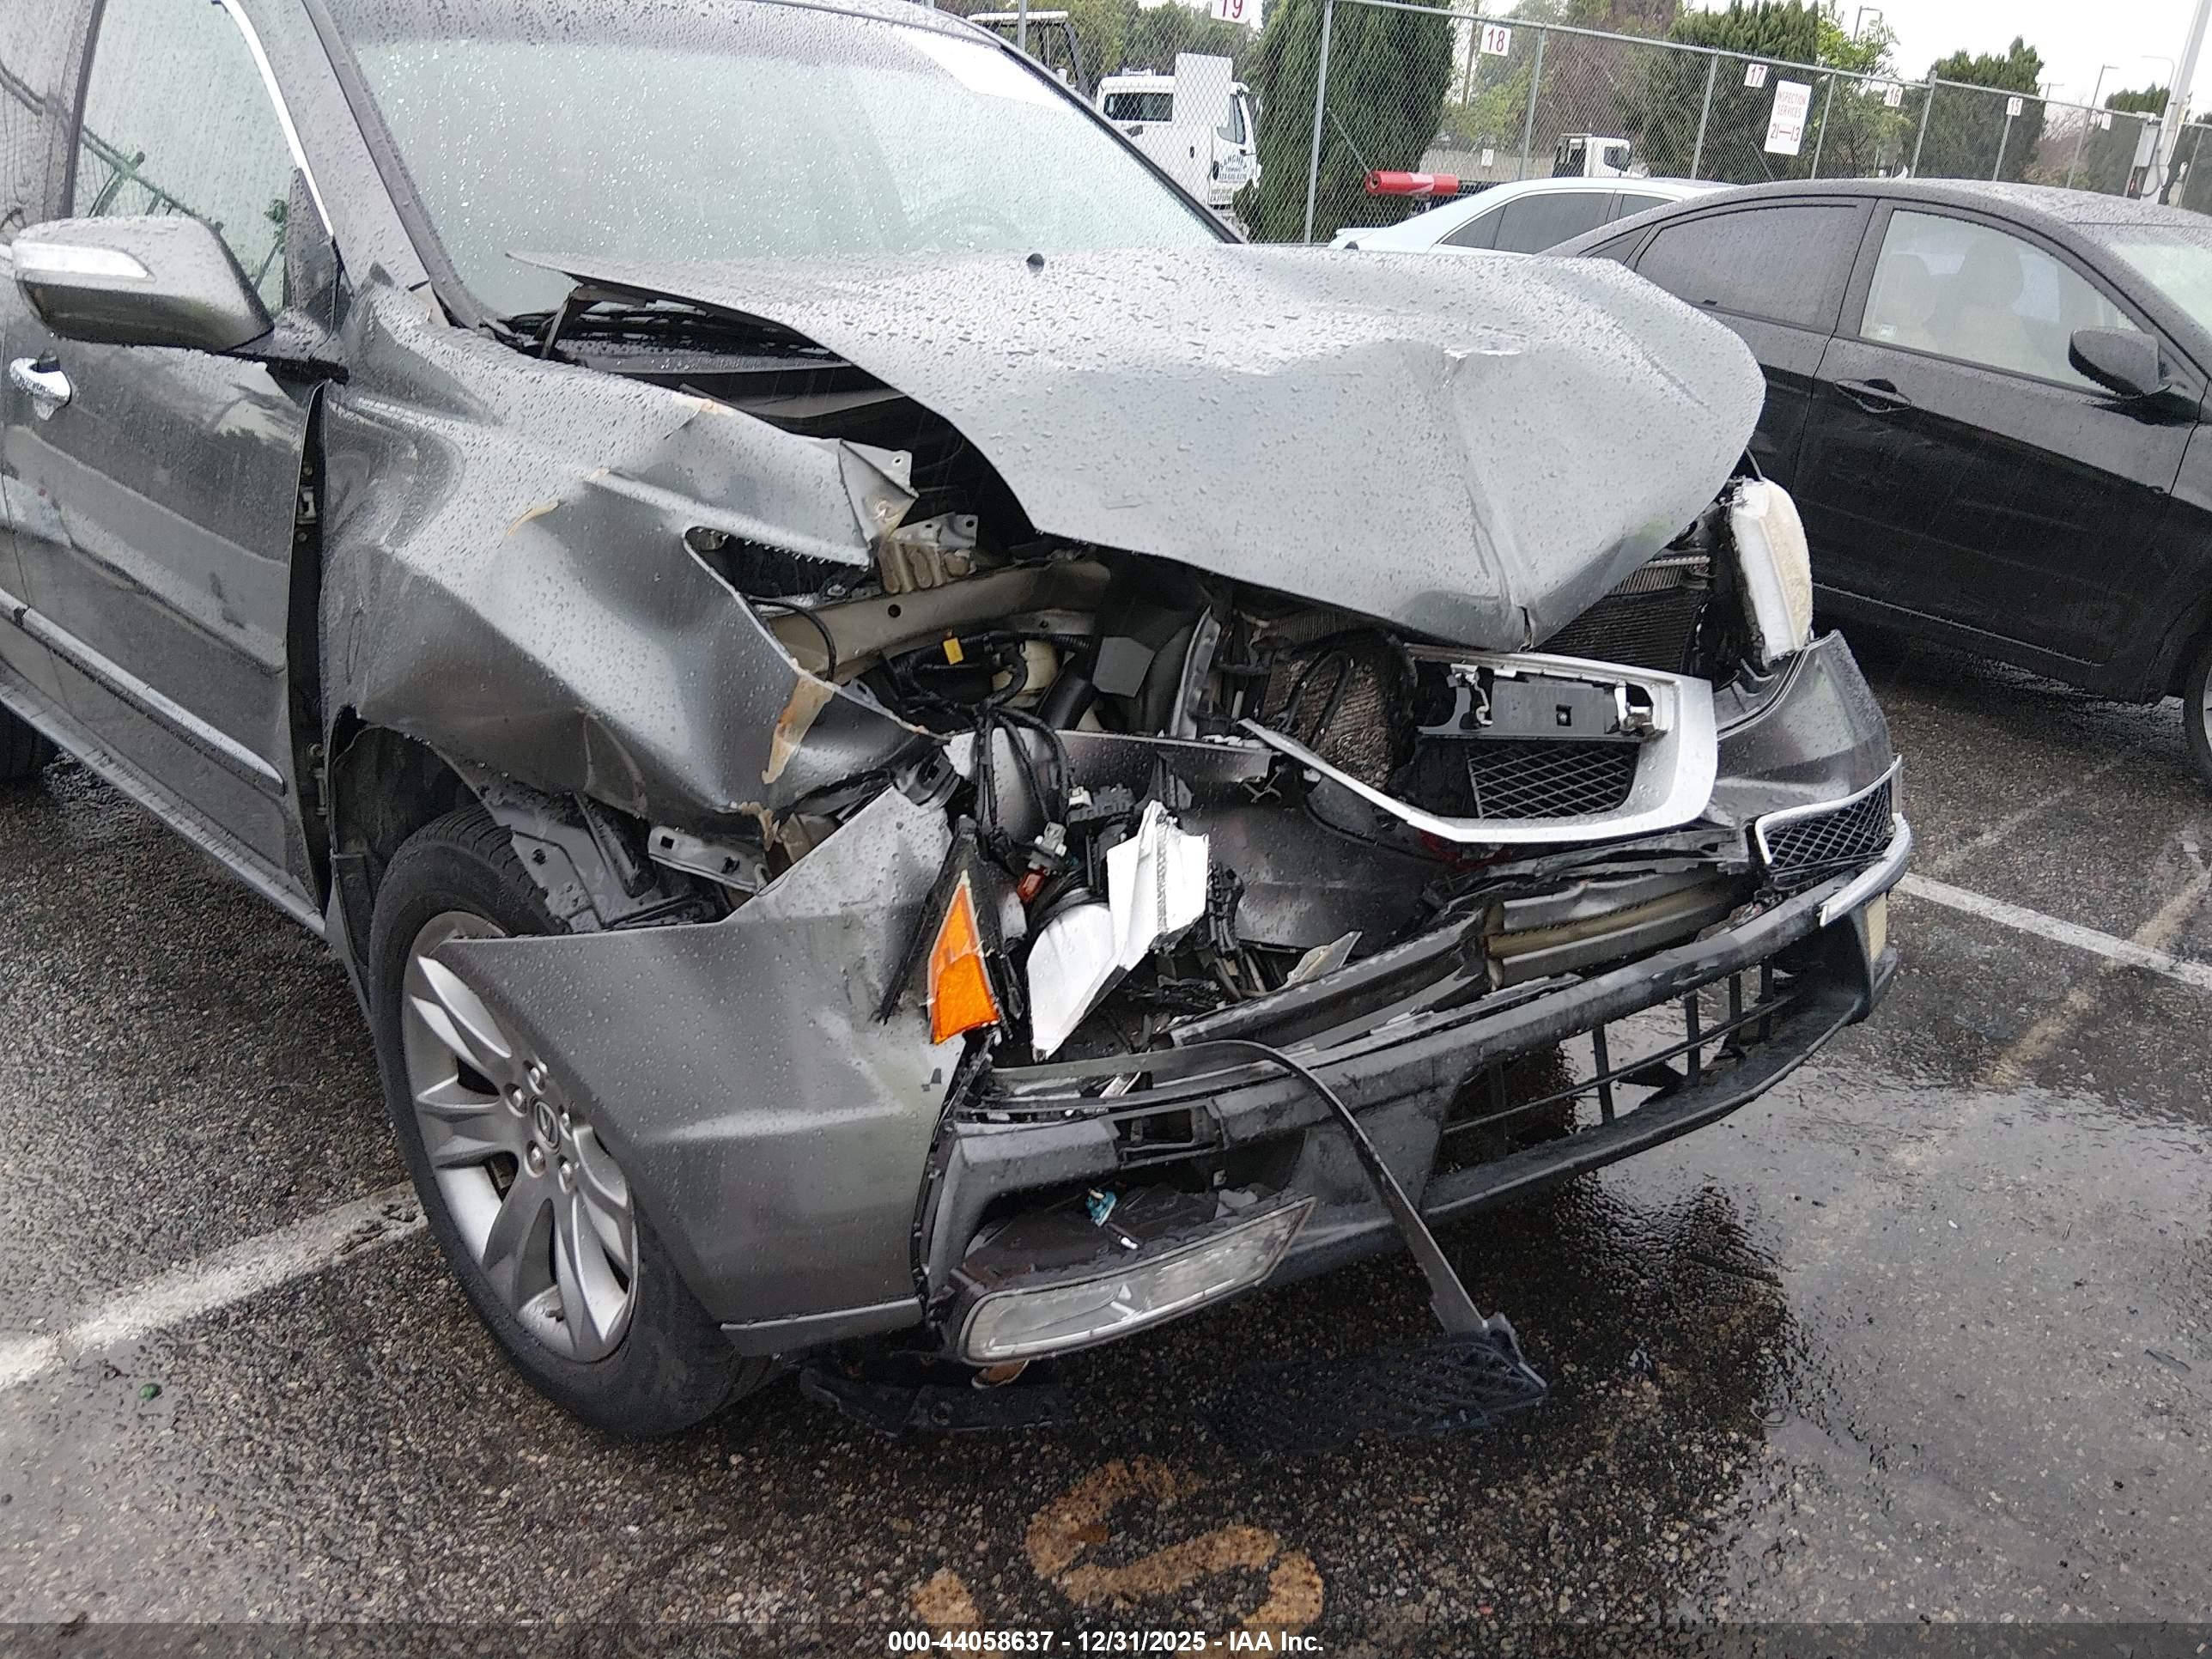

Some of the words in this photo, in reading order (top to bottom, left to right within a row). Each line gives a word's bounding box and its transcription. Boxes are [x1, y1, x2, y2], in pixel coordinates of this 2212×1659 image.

[1221, 0, 1243, 19] 19
[1487, 27, 1505, 52] 18
[1750, 65, 1765, 86] 17
[1776, 90, 1807, 106] INSPECTION
[1890, 88, 1900, 105] 16
[1777, 104, 1802, 118] SERVICES
